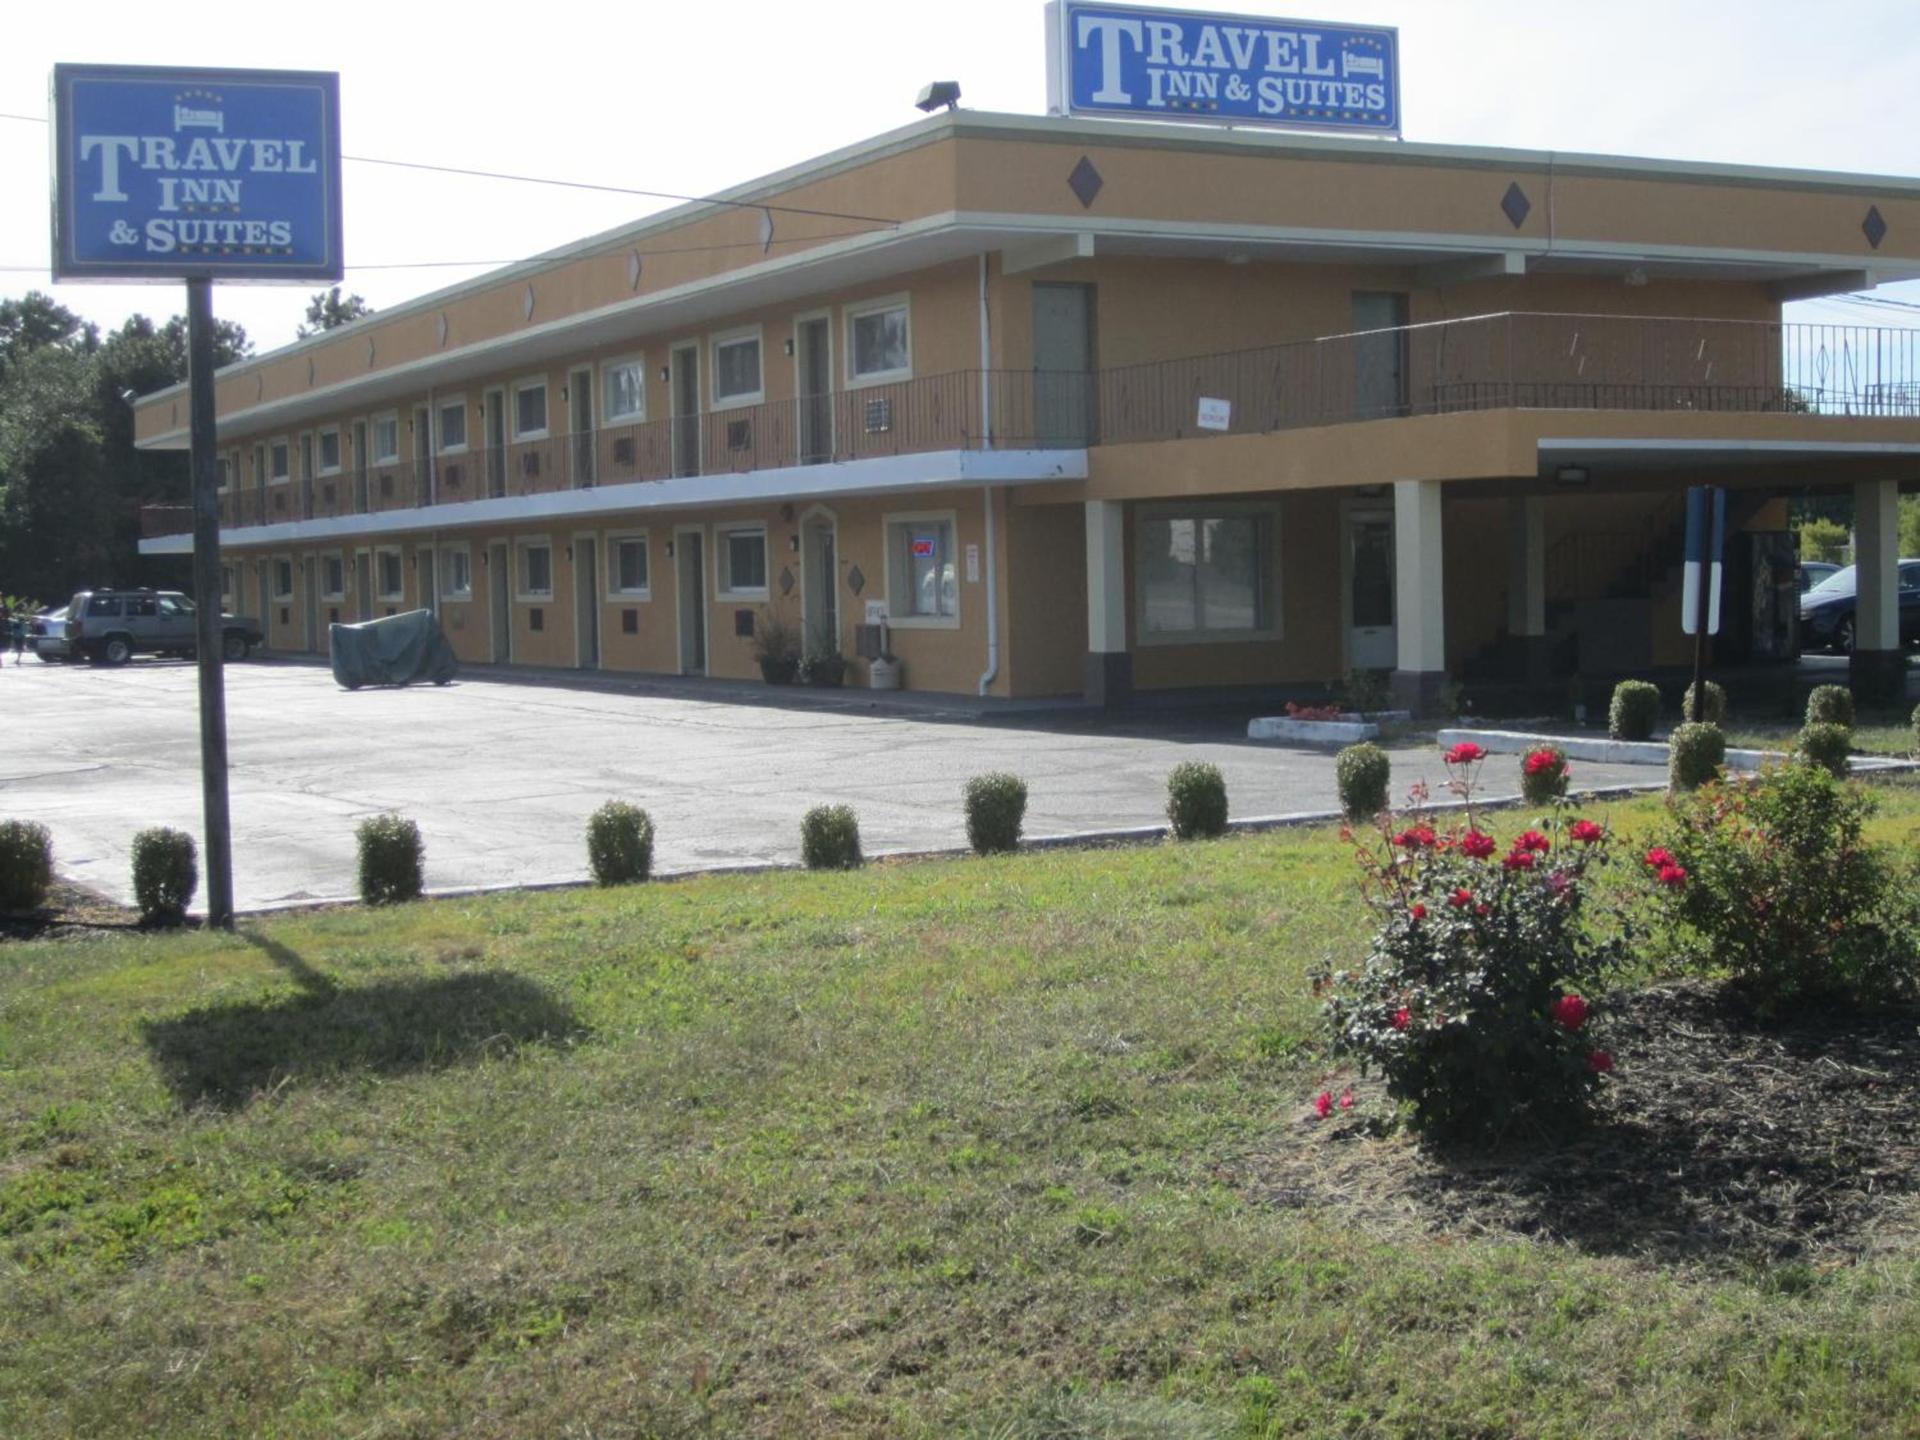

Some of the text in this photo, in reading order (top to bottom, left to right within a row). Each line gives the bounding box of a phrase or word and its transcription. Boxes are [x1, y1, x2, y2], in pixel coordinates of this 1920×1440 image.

[1077, 16, 1335, 105] TRAVEL
[1147, 69, 1385, 114] INN & SUITES
[80, 135, 317, 202] TRAVEL
[158, 178, 242, 211] INN
[109, 218, 292, 252] & SUITES
